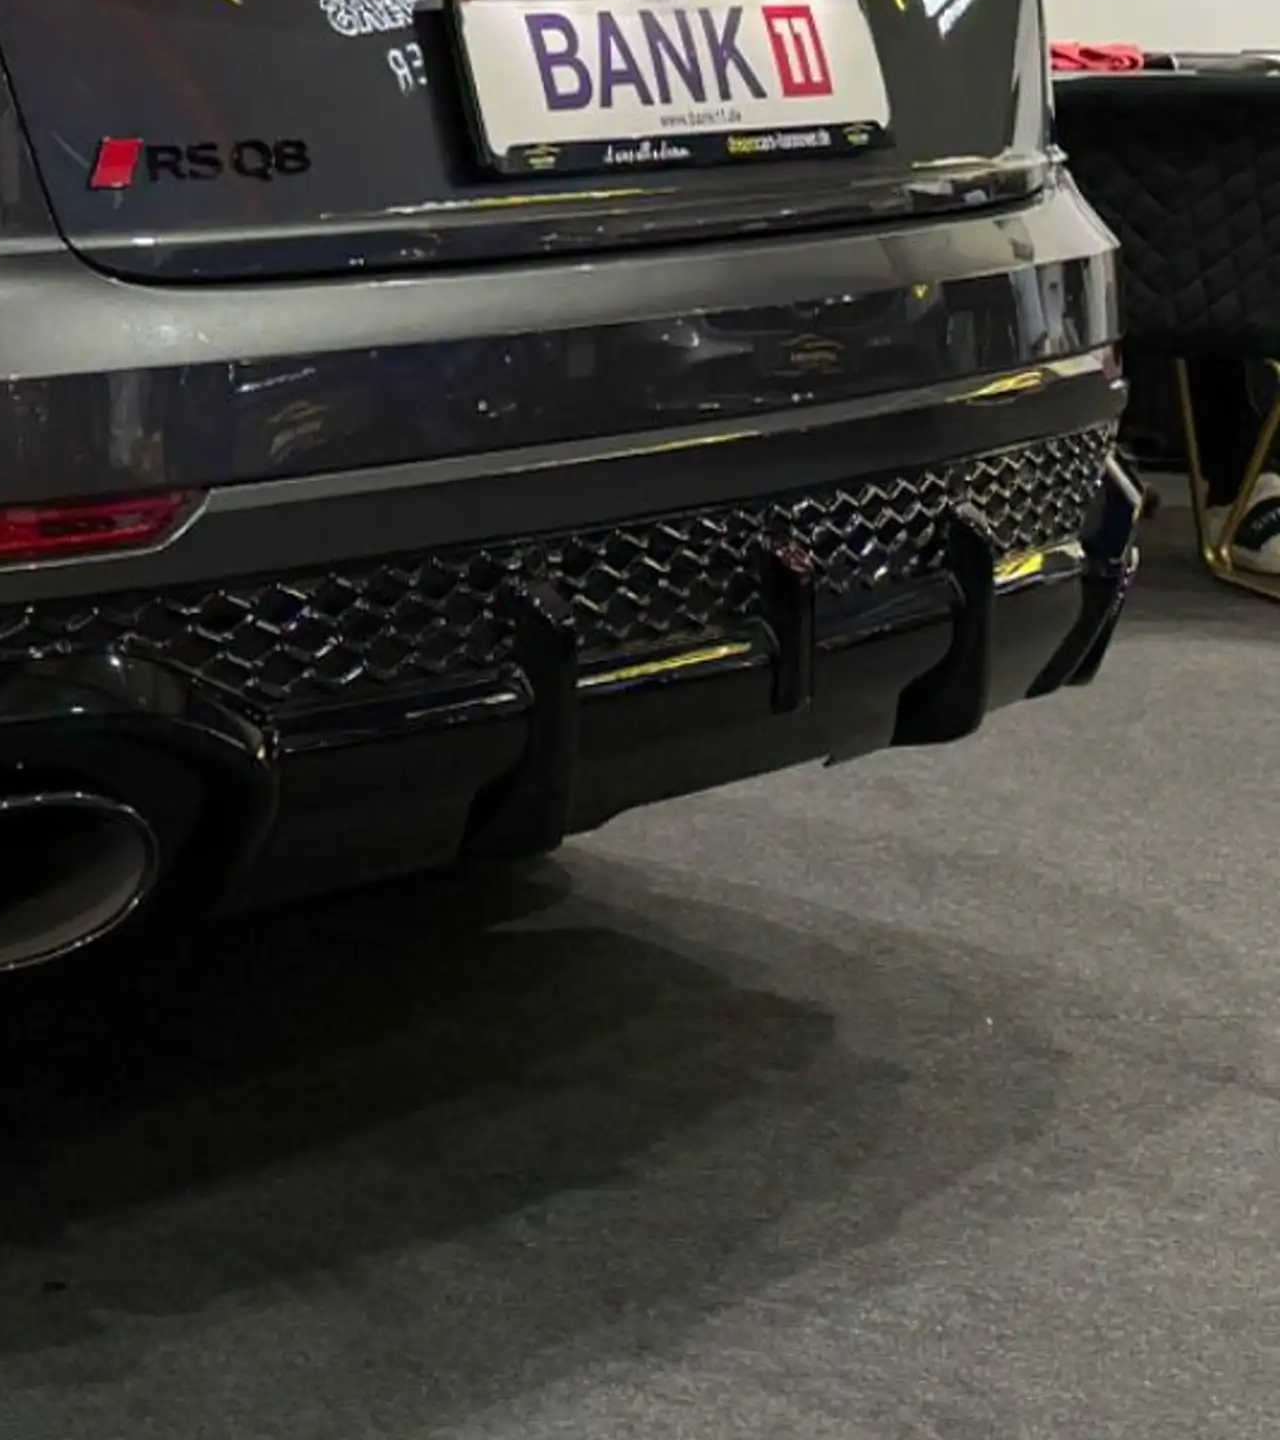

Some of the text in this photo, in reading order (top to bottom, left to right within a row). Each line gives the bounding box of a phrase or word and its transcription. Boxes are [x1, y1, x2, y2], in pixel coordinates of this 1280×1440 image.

[524, 5, 824, 111] BANK 11
[145, 138, 312, 182] RS Q8
